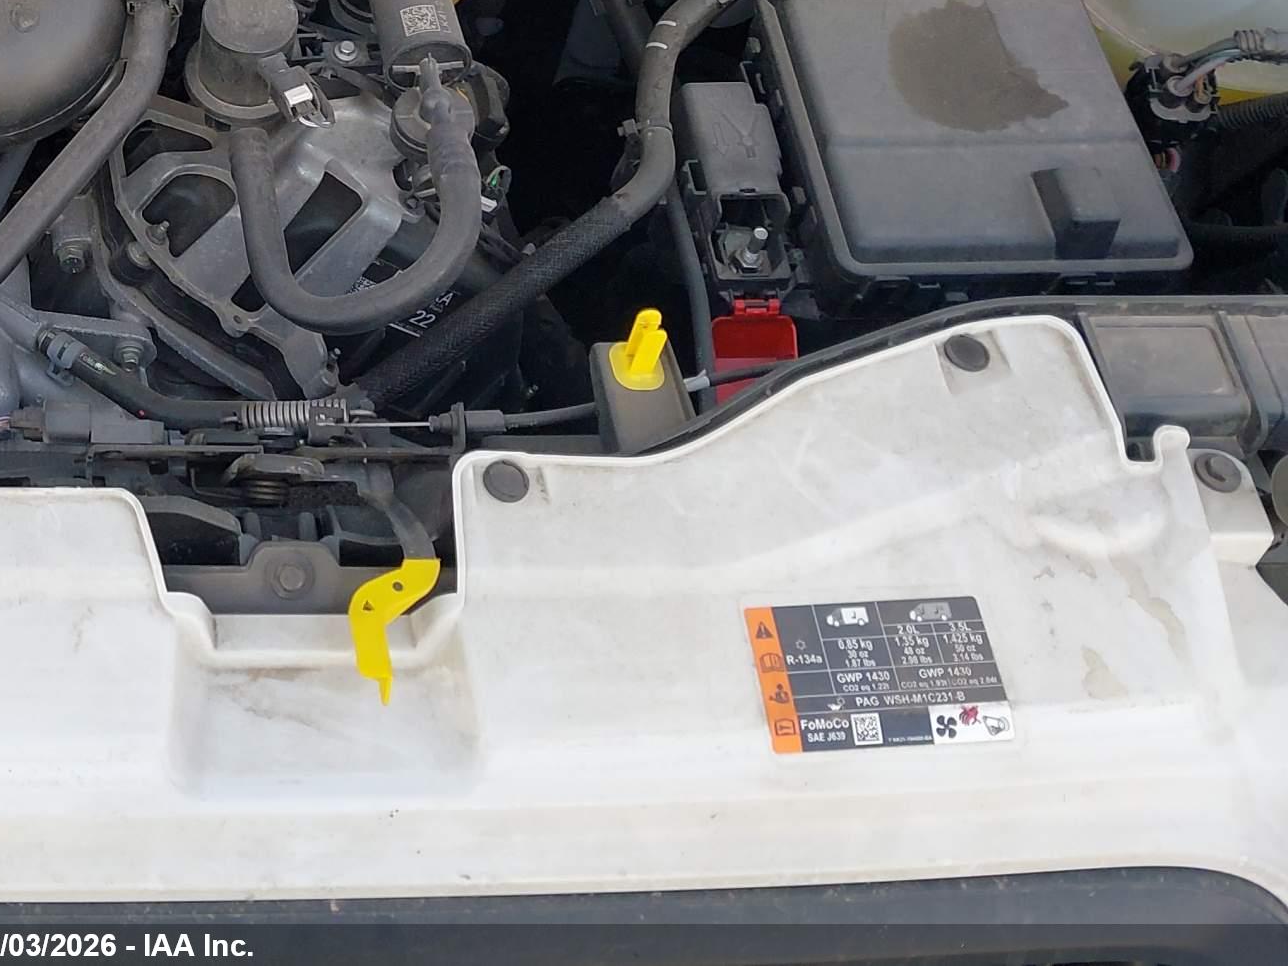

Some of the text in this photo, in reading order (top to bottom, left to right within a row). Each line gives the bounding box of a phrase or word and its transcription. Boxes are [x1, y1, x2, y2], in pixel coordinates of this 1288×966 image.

[409, 307, 435, 330] 22
[897, 625, 920, 634] 2.0L
[949, 622, 971, 632] 3.5L
[860, 637, 873, 651] kg
[895, 635, 930, 648] 1.35 kg
[943, 632, 983, 645] 1.425 kg
[786, 655, 823, 666] R-134a
[847, 651, 857, 659] 30
[919, 655, 932, 664] lbs
[971, 652, 984, 661] lbs
[845, 659, 876, 668] 1.87 lbs
[837, 671, 890, 684] GWP 1430
[919, 667, 972, 679] GWP 1430
[843, 684, 859, 692] CO2
[855, 691, 966, 707] PAG WSH-M1C231-B
[800, 718, 849, 731] FoMoCo
[807, 731, 846, 743] SAE J639
